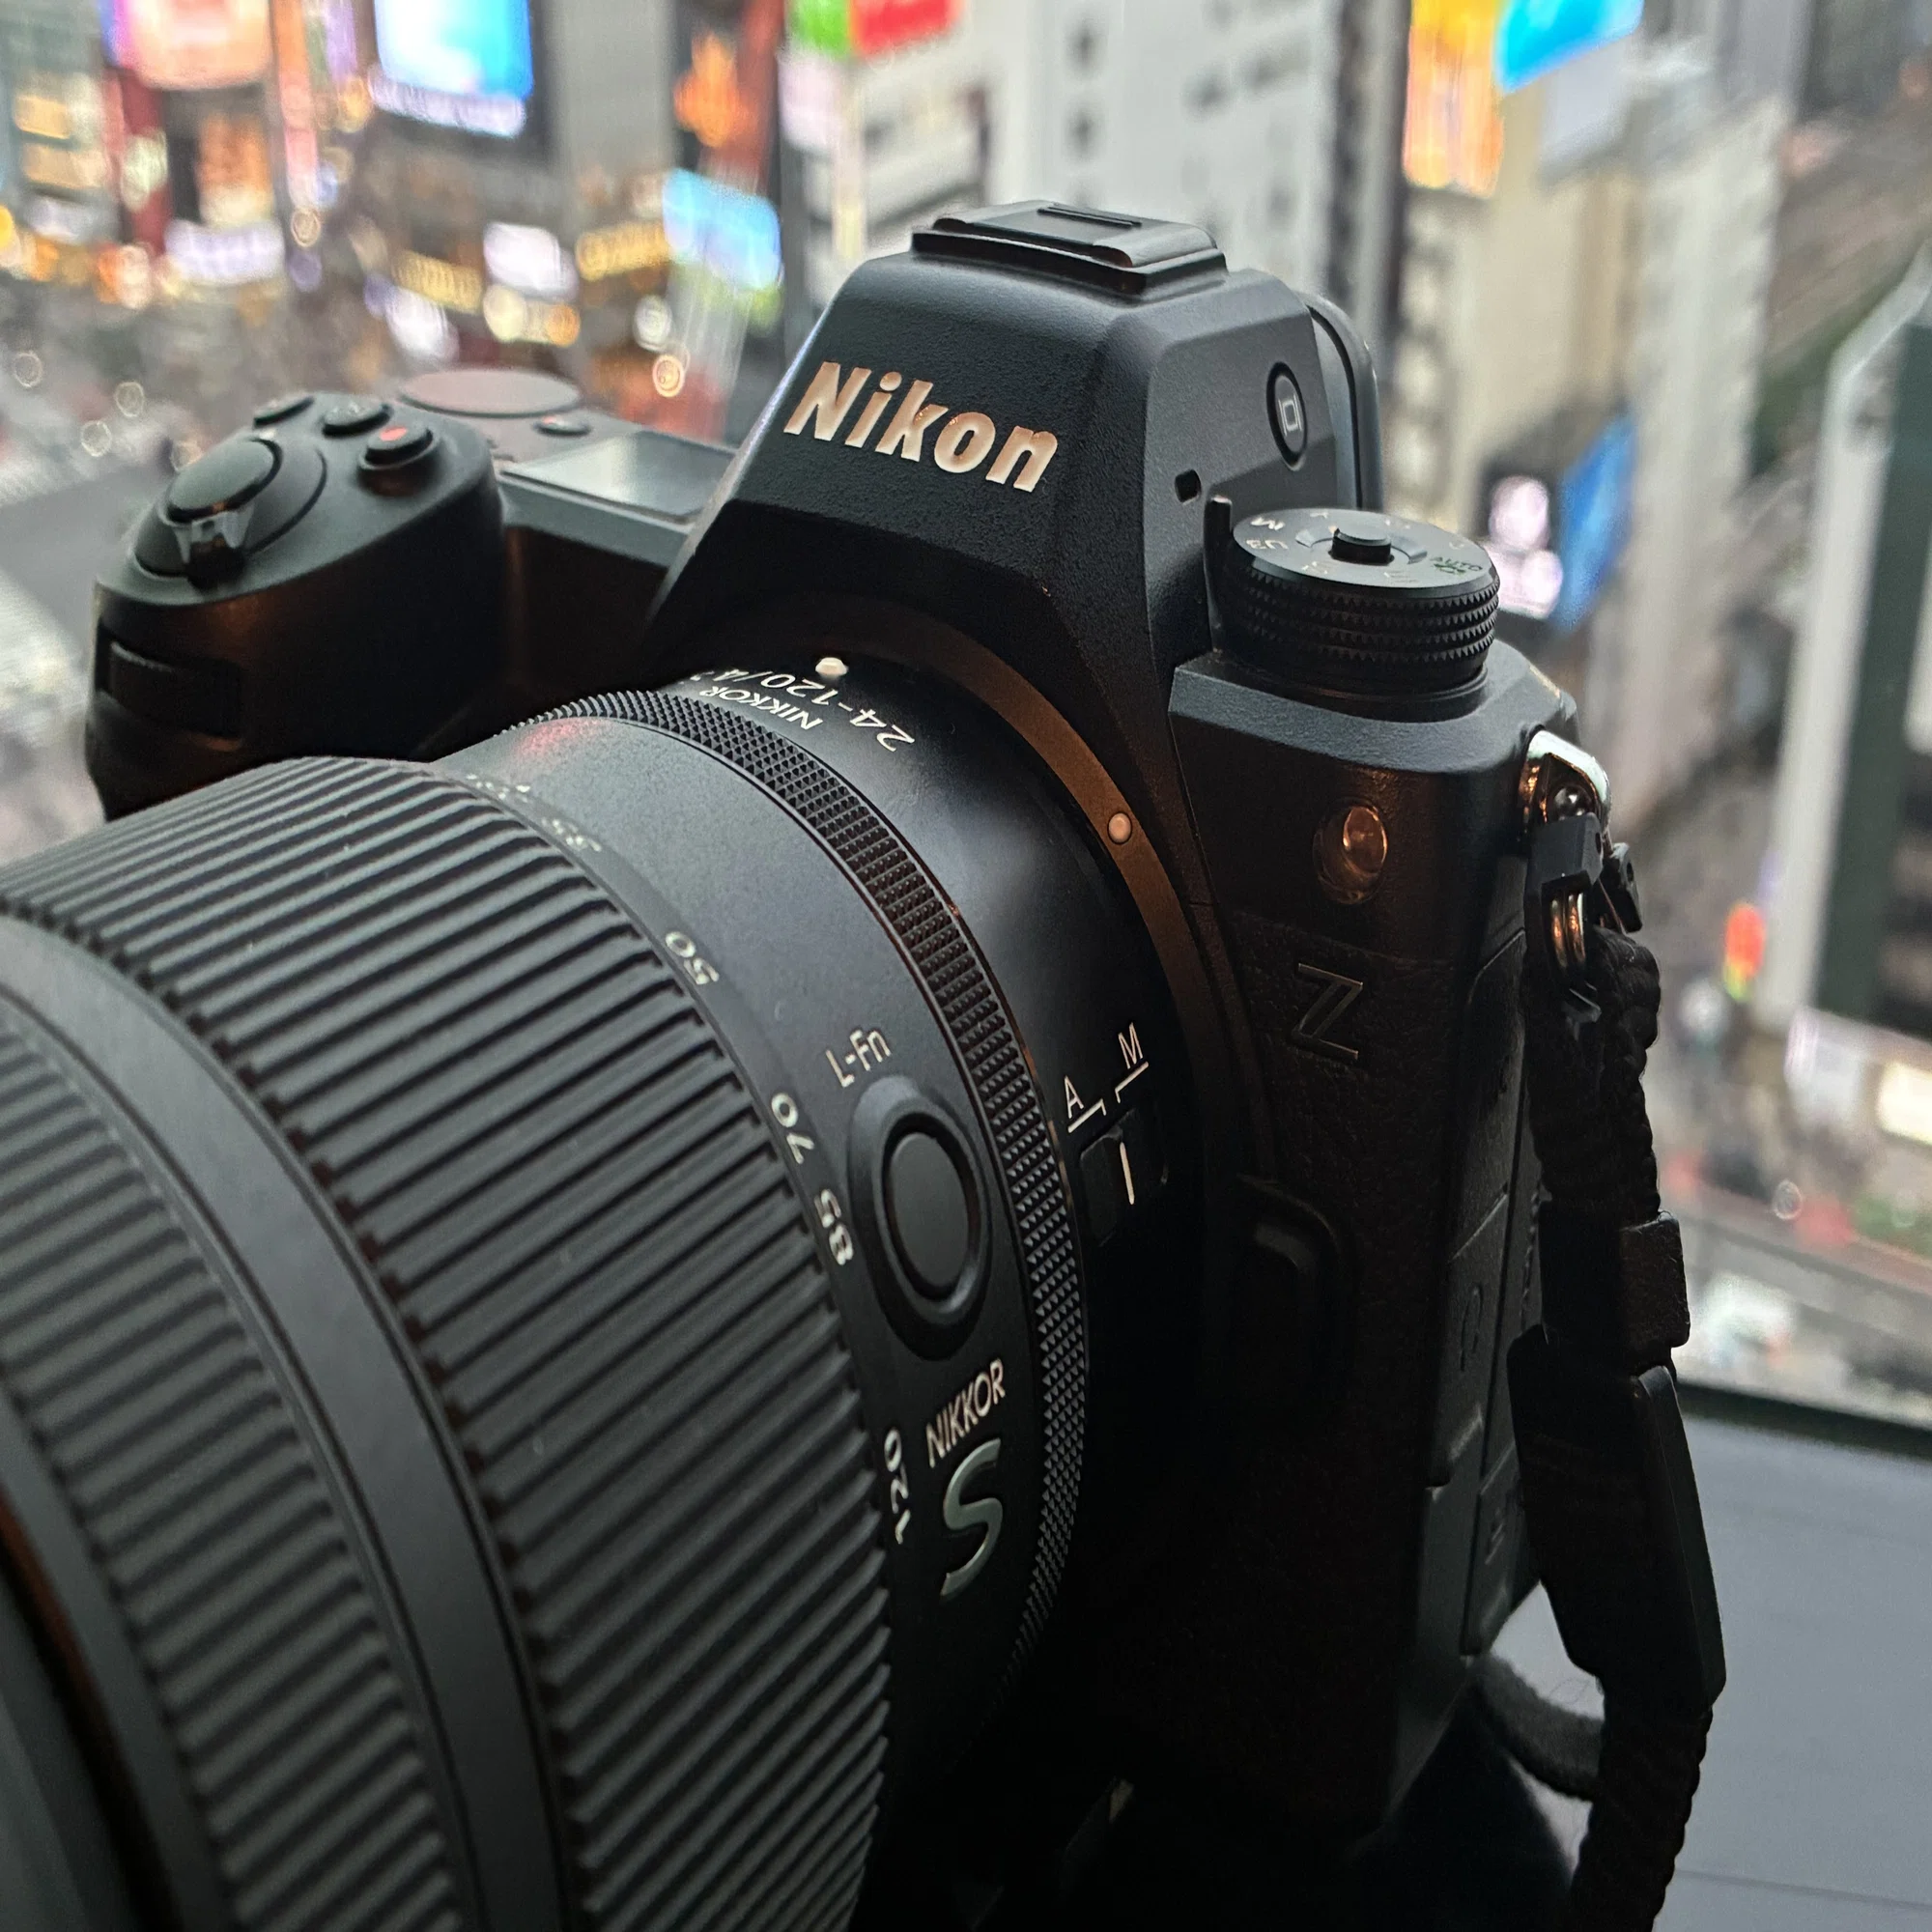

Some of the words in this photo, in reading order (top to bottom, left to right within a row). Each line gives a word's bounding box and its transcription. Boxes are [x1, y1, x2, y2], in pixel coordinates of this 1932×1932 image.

[783, 361, 1059, 493] Nikon
[698, 686, 823, 730] NIKKOR
[1117, 1021, 1144, 1069] M
[1292, 962, 1364, 1061] Z
[825, 1028, 892, 1088] L-Fn
[771, 1092, 814, 1165] 70
[1064, 1075, 1085, 1120] A
[813, 1188, 854, 1266] 85
[924, 1357, 1007, 1468] NIKKOR
[883, 1427, 911, 1546] 120
[939, 1436, 1004, 1600] S
